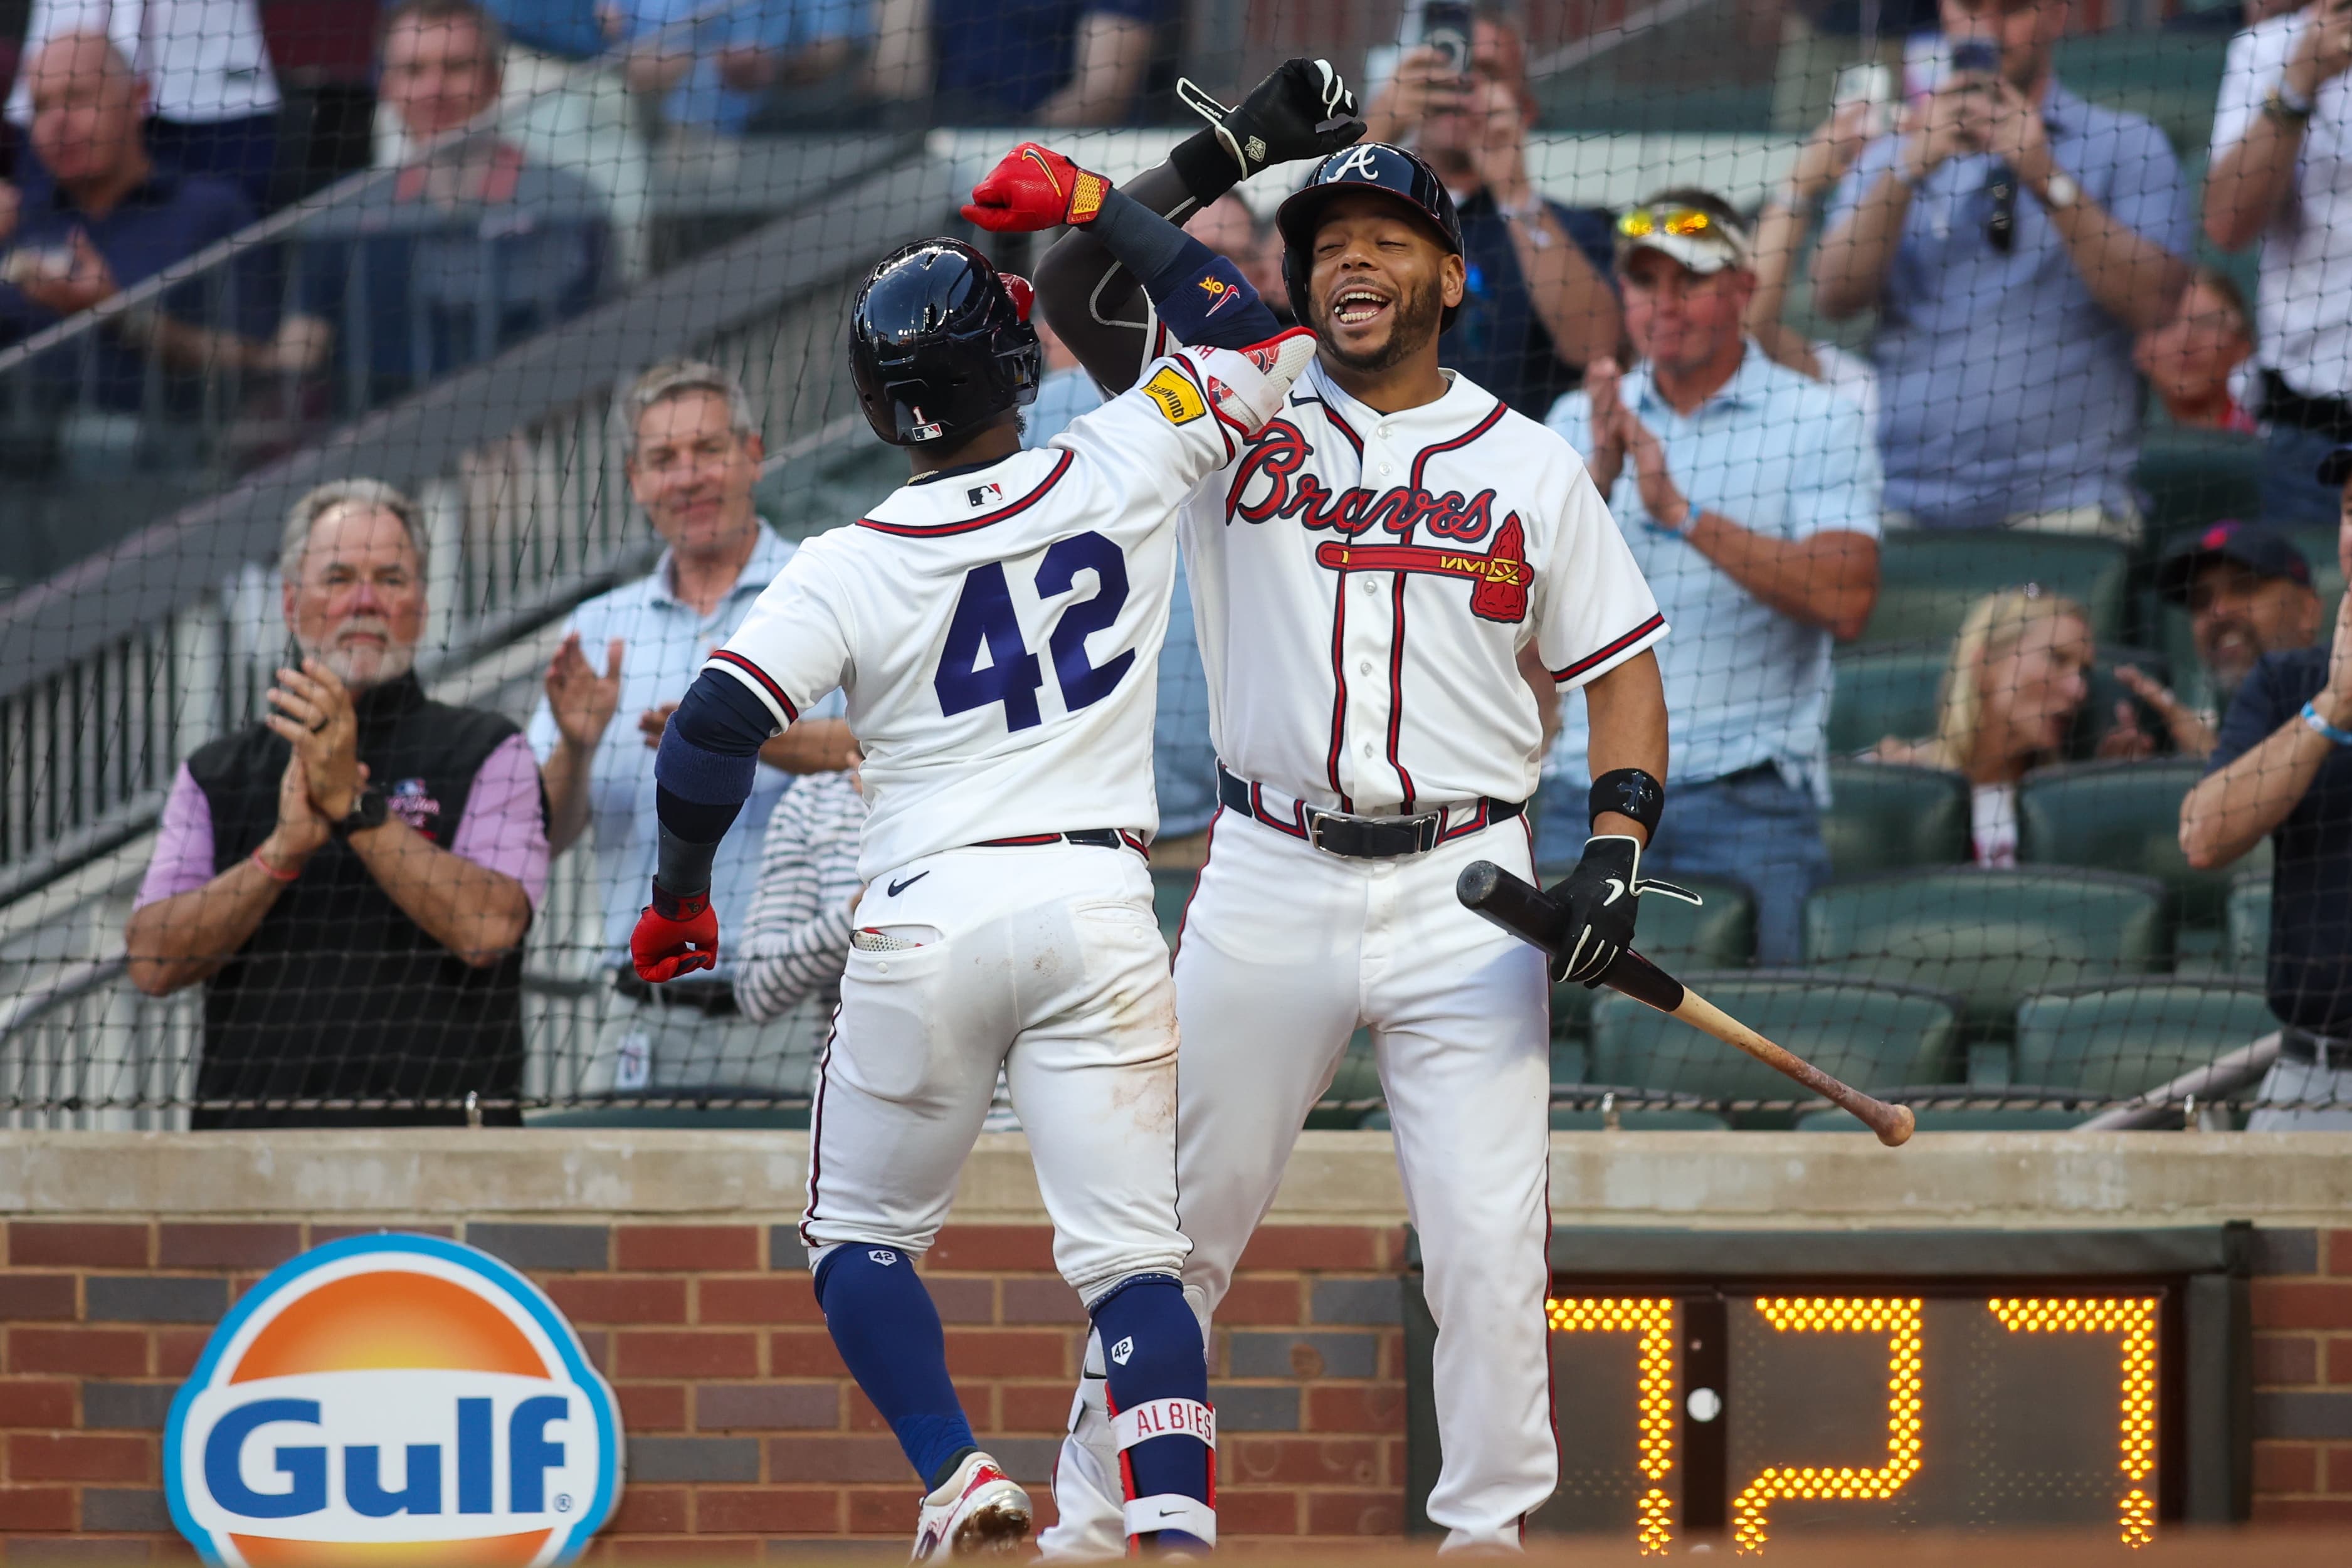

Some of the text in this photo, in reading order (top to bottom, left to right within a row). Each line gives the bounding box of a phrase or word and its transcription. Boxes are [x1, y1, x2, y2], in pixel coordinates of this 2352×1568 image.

[1326, 144, 1378, 182] A
[1071, 214, 1091, 222] ELITE
[912, 406, 927, 425] 1
[1226, 418, 1497, 544] Braves
[934, 530, 1136, 734] 42
[873, 1251, 894, 1261] 42
[1114, 1341, 1131, 1359] 42
[1137, 1402, 1212, 1441] ALBIES
[204, 1395, 569, 1520] Gulf
